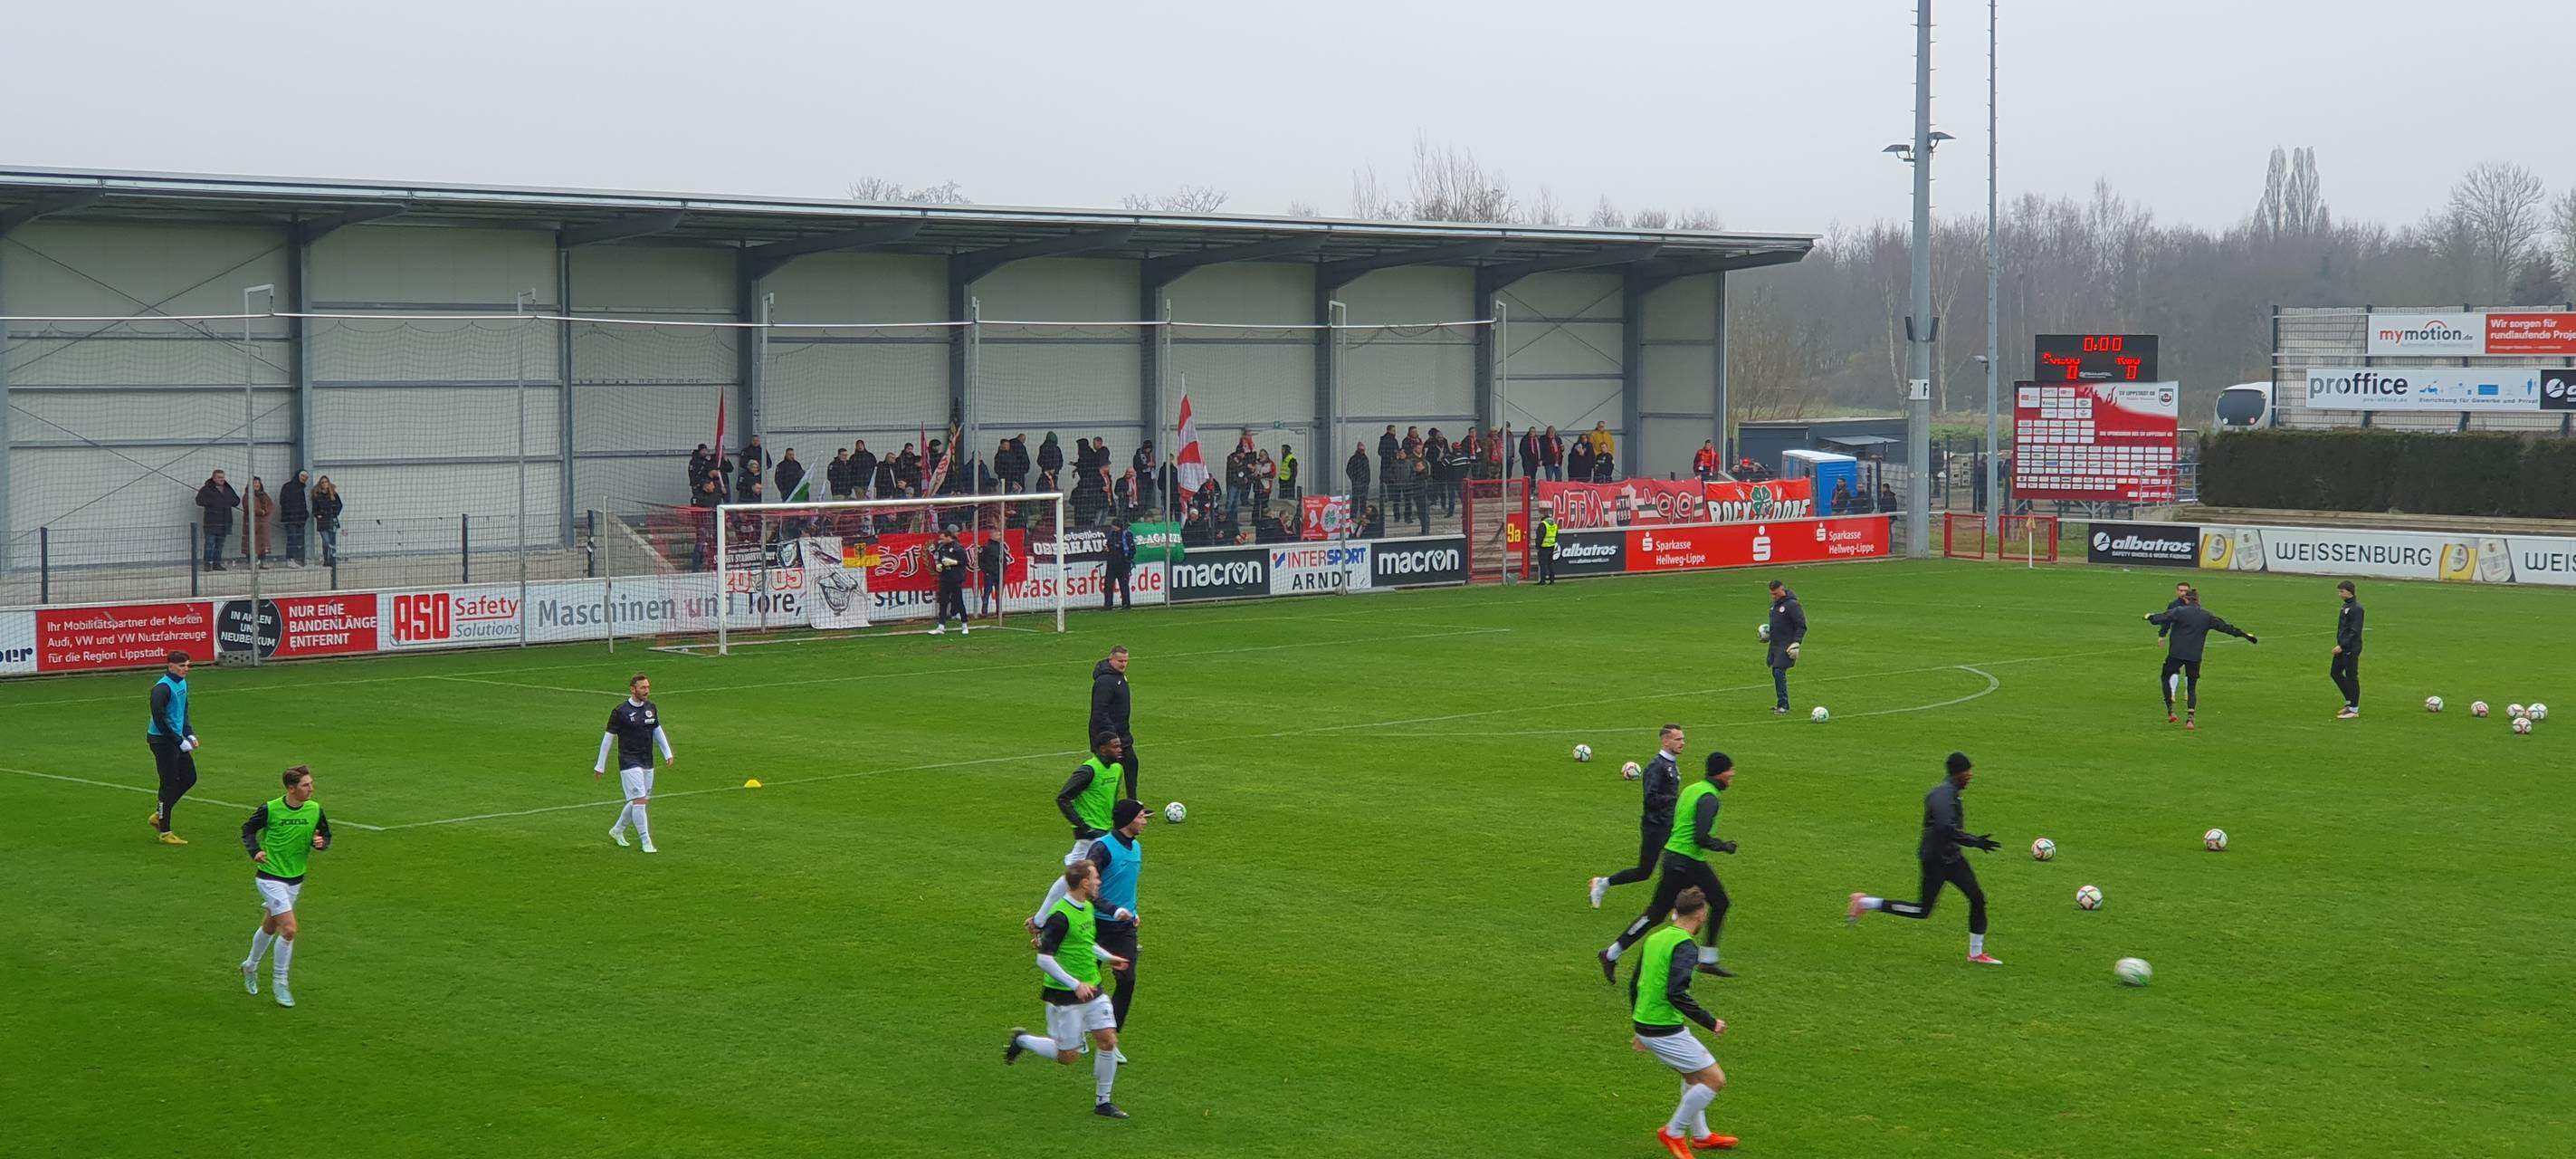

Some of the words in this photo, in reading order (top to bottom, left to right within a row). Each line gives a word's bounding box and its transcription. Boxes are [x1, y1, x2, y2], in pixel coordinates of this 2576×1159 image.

[2491, 319, 2507, 328] Wir
[2510, 321, 2541, 330] sorgen
[2543, 319, 2557, 328] für
[2491, 330, 2552, 340] rundlaufende
[2084, 336, 2123, 352] 0:00
[2310, 372, 2409, 399] proffice
[1507, 523, 1521, 542] 9a
[1829, 531, 1861, 541] Sparkasse
[1561, 543, 1617, 558] albatros
[1655, 541, 1692, 552] Sparkasse
[1829, 542, 1875, 555] Hellweg-Lippe
[2112, 536, 2194, 552] albatros
[1288, 547, 1366, 569] INTERSPORT
[1379, 549, 1459, 575] macron
[1655, 553, 1705, 567] Hellweg-Lippe
[2276, 542, 2432, 567] WEISSENBURG
[1172, 560, 1262, 588] macron
[1292, 570, 1352, 590] ARNDT
[289, 605, 314, 618] NUR
[318, 604, 345, 616] EINE
[454, 595, 520, 618] Safety
[539, 593, 675, 627] Maschinen
[47, 621, 60, 632] Ihr
[64, 618, 147, 631] Mobilitätspartner
[150, 616, 165, 626] der
[168, 615, 202, 625] Marken
[231, 611, 241, 620] IN
[290, 615, 377, 633] BANDENLÄNGE
[394, 593, 450, 641] ASO
[454, 621, 520, 637] Solutions
[47, 637, 72, 648] Audi,
[75, 637, 93, 647] VW
[96, 635, 115, 645] und
[118, 634, 136, 643] VW
[138, 630, 206, 642] Nutzfahrzeuge
[290, 633, 349, 648] ENTFERNT
[48, 653, 62, 664] für
[65, 651, 81, 662] die
[83, 649, 117, 664] Region
[119, 647, 167, 660] Lippstadt.
